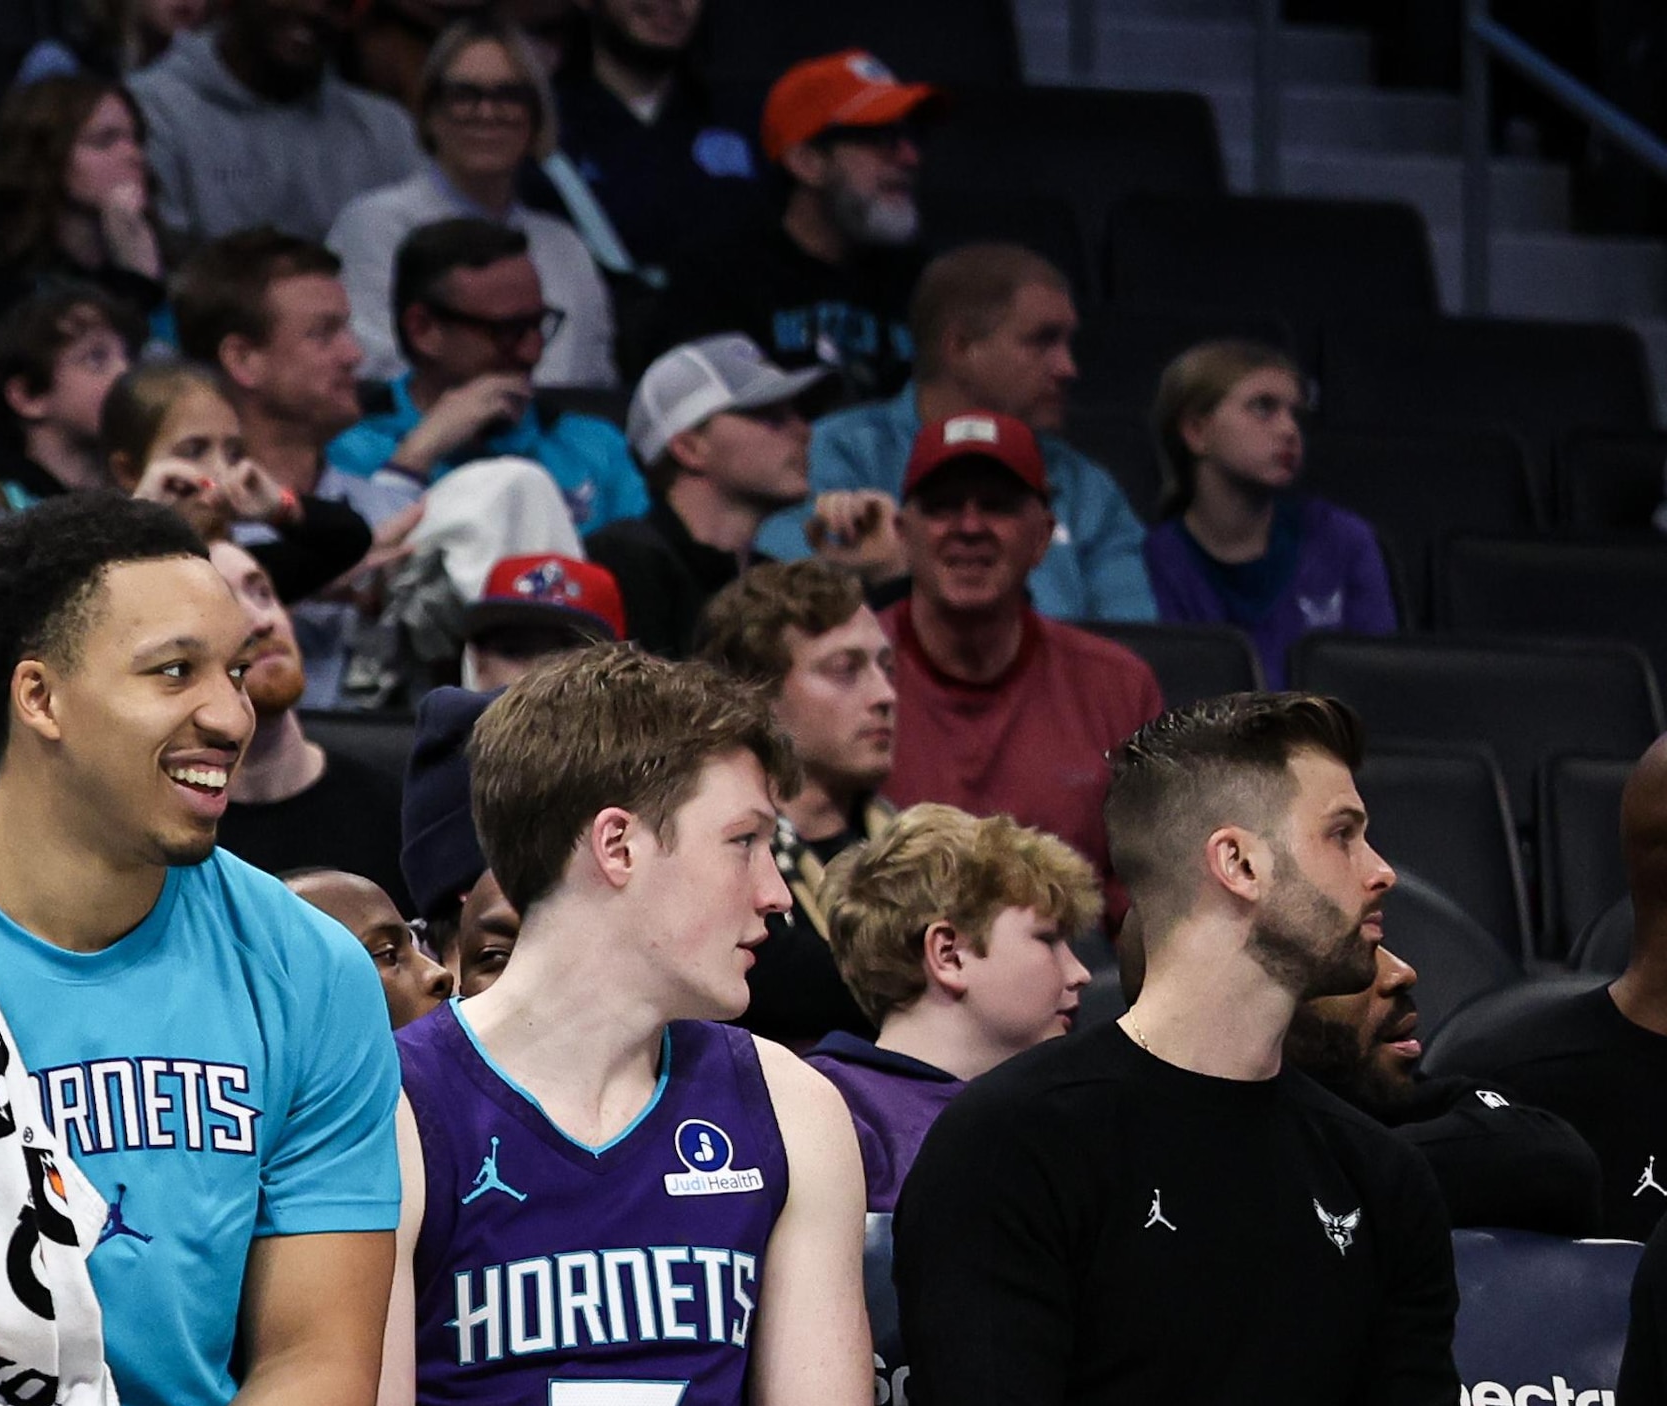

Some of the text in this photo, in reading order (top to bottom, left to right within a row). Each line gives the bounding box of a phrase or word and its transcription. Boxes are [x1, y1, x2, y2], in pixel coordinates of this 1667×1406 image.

[27, 1057, 265, 1156] RNETS
[671, 1172, 760, 1192] Judi Health
[443, 1246, 756, 1366] HORNETS
